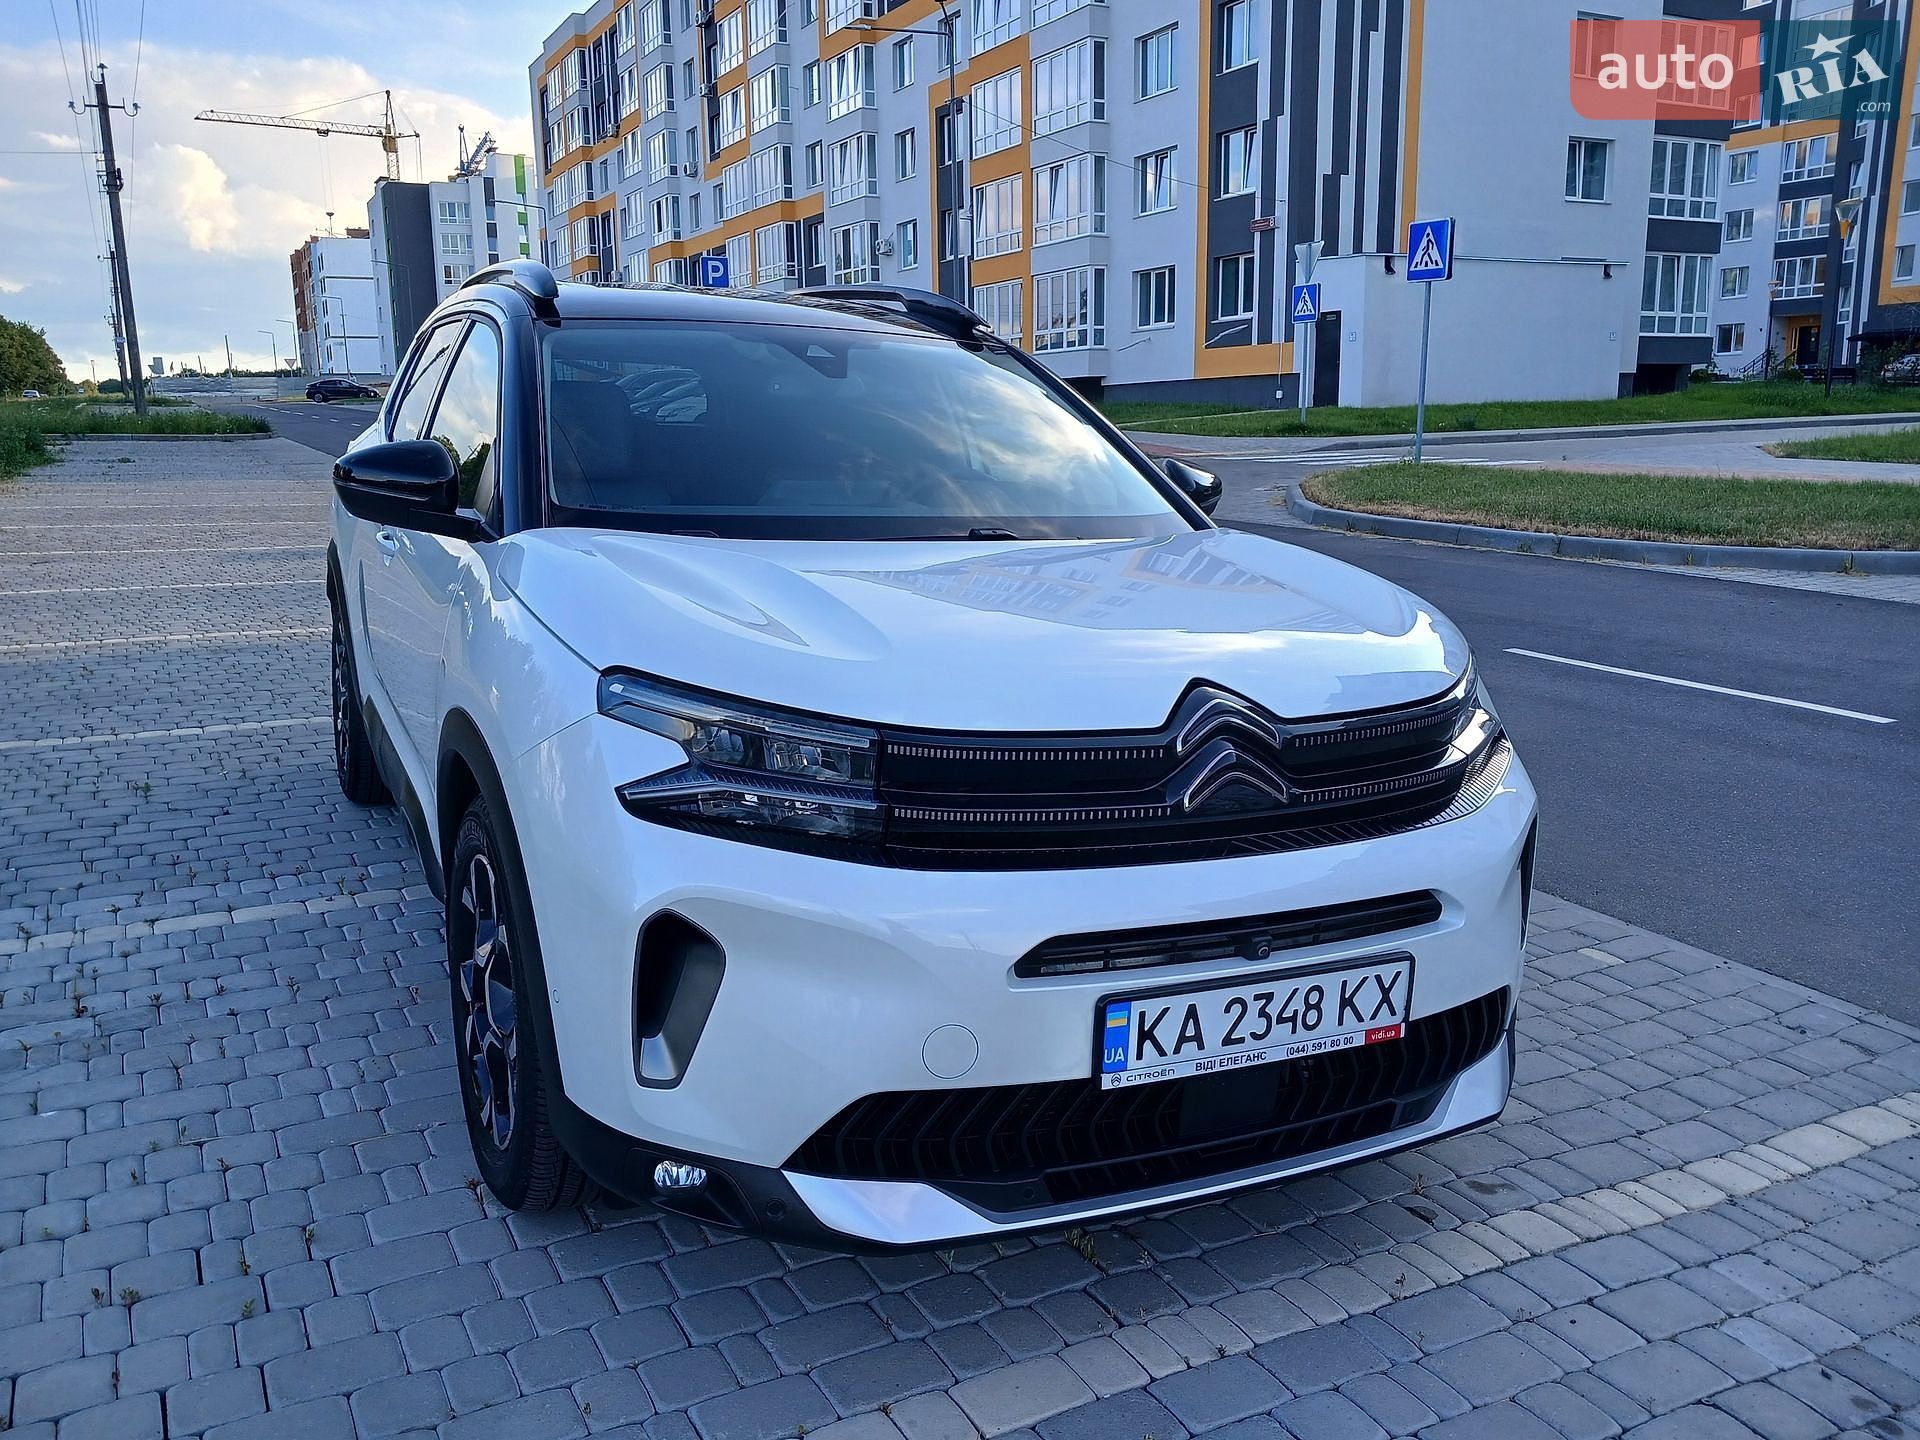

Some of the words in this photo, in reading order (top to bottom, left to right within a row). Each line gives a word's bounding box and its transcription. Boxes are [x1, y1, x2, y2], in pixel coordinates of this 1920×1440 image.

[1269, 217, 1275, 227] 8
[707, 260, 724, 285] P
[1135, 1002, 1206, 1061] KA
[1220, 984, 1325, 1047] 2348
[1337, 970, 1403, 1027] KX
[1371, 1029, 1396, 1041] vidi.ua
[1104, 1046, 1125, 1064] UA
[1286, 1042, 1309, 1058] (044)
[1311, 1040, 1327, 1051] 591
[1330, 1037, 1341, 1047] 80
[1343, 1035, 1354, 1045] 00
[1195, 1060, 1217, 1072] ВІДІ
[1219, 1051, 1267, 1068] ЕЛЕГАНС
